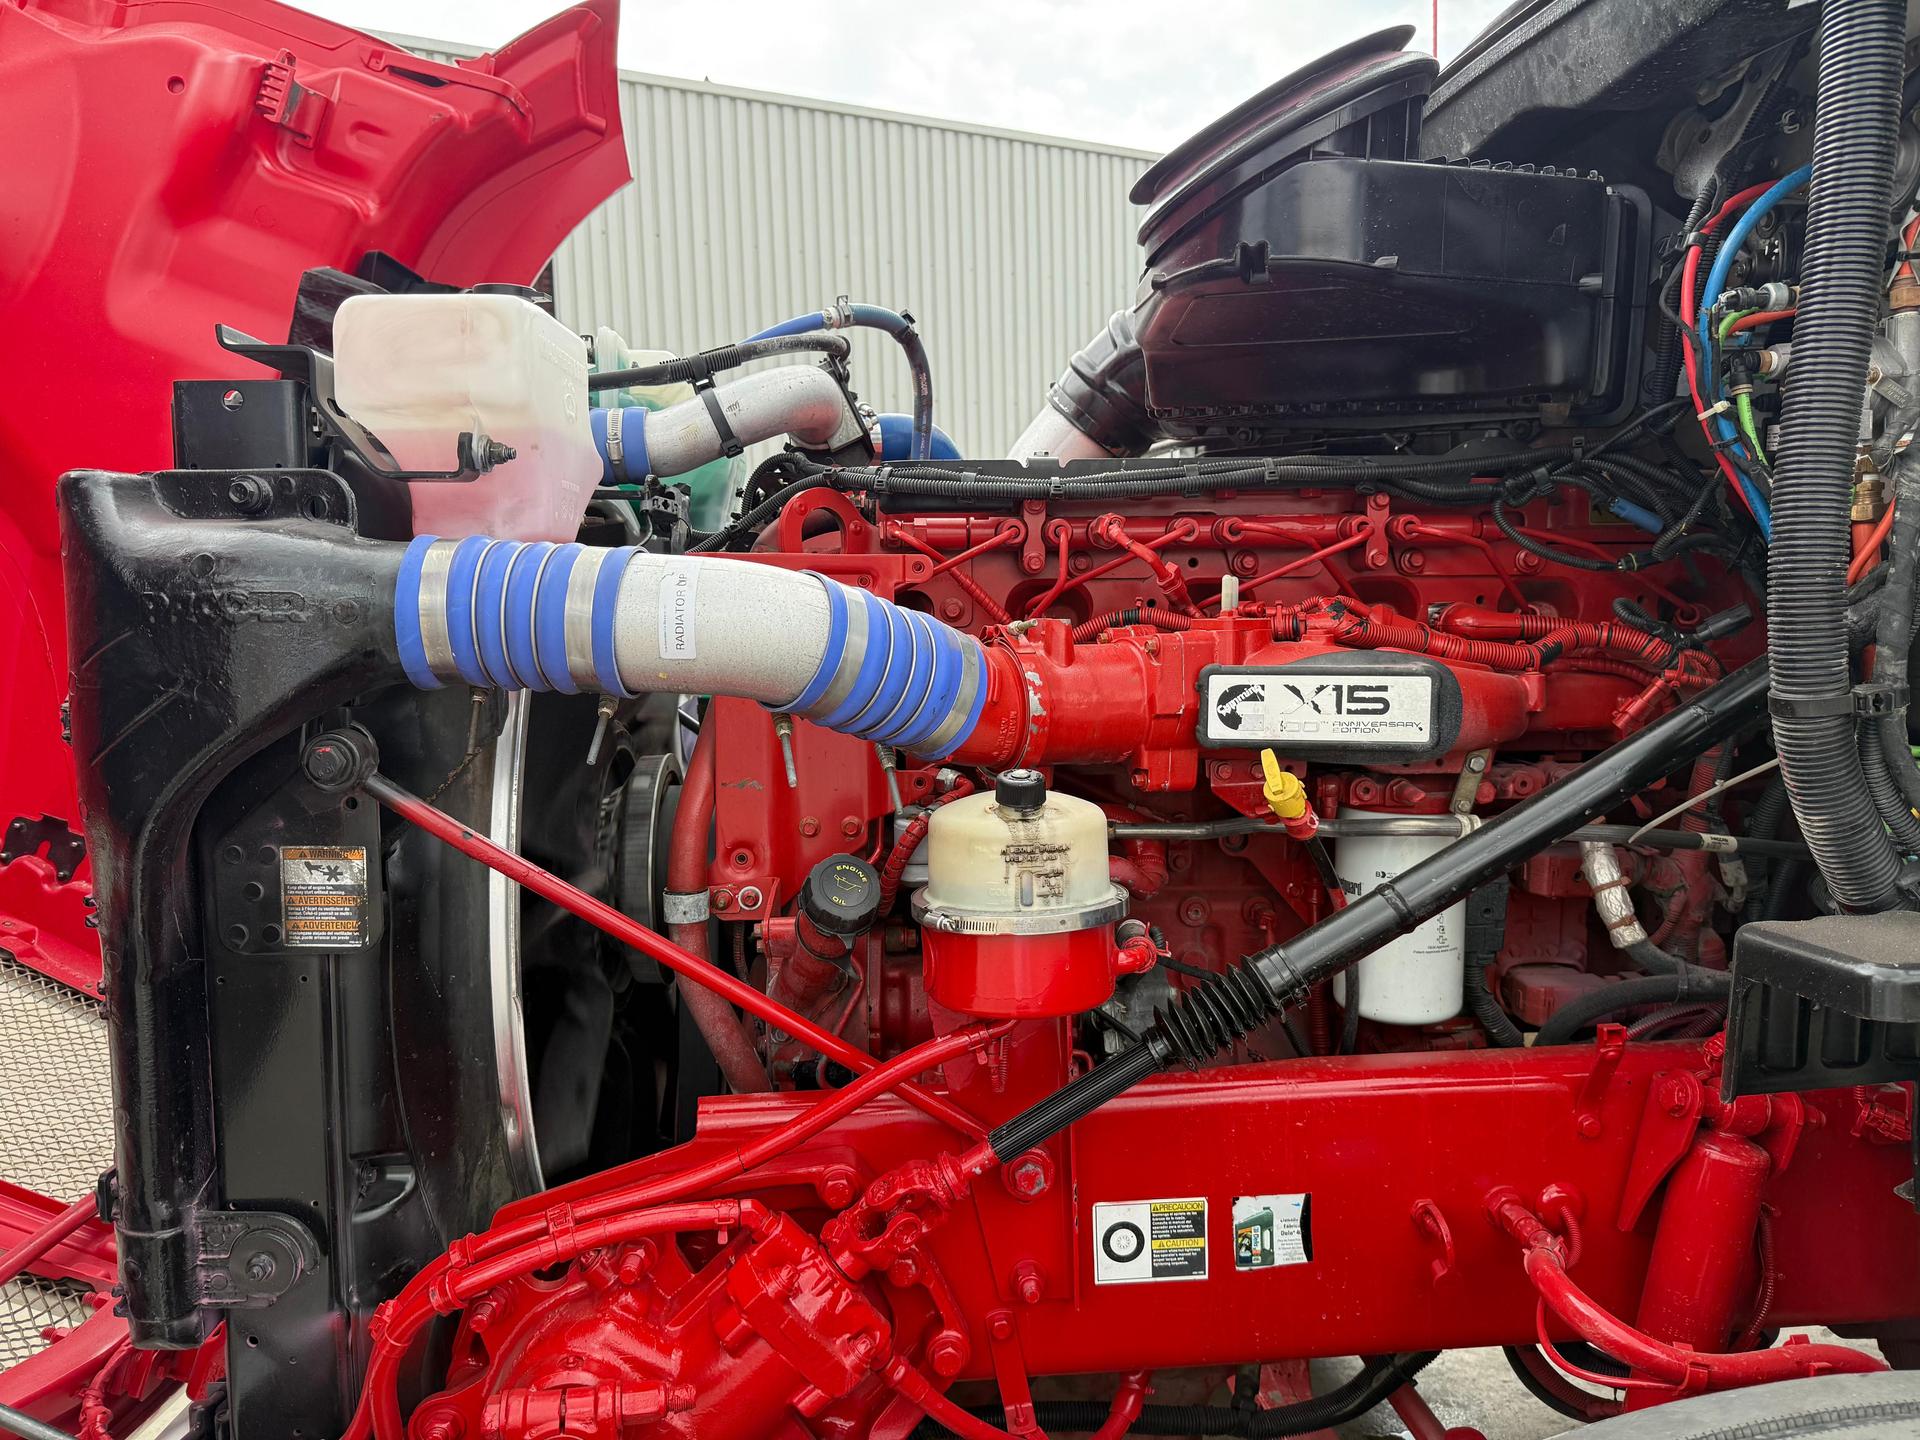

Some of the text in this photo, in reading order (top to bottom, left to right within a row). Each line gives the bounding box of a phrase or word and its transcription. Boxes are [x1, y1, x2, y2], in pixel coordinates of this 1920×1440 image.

[675, 590, 687, 650] RADIATOR
[1280, 684, 1391, 716] X15
[1332, 720, 1421, 729] ANNIVERSARY
[309, 850, 349, 858] WARNING
[835, 864, 868, 883] ENGINE
[299, 896, 358, 905] AVERTISSEMEN
[832, 895, 847, 906] OIL
[1159, 1202, 1203, 1211] PRECAUCION
[1165, 1239, 1199, 1248] CAUTION
